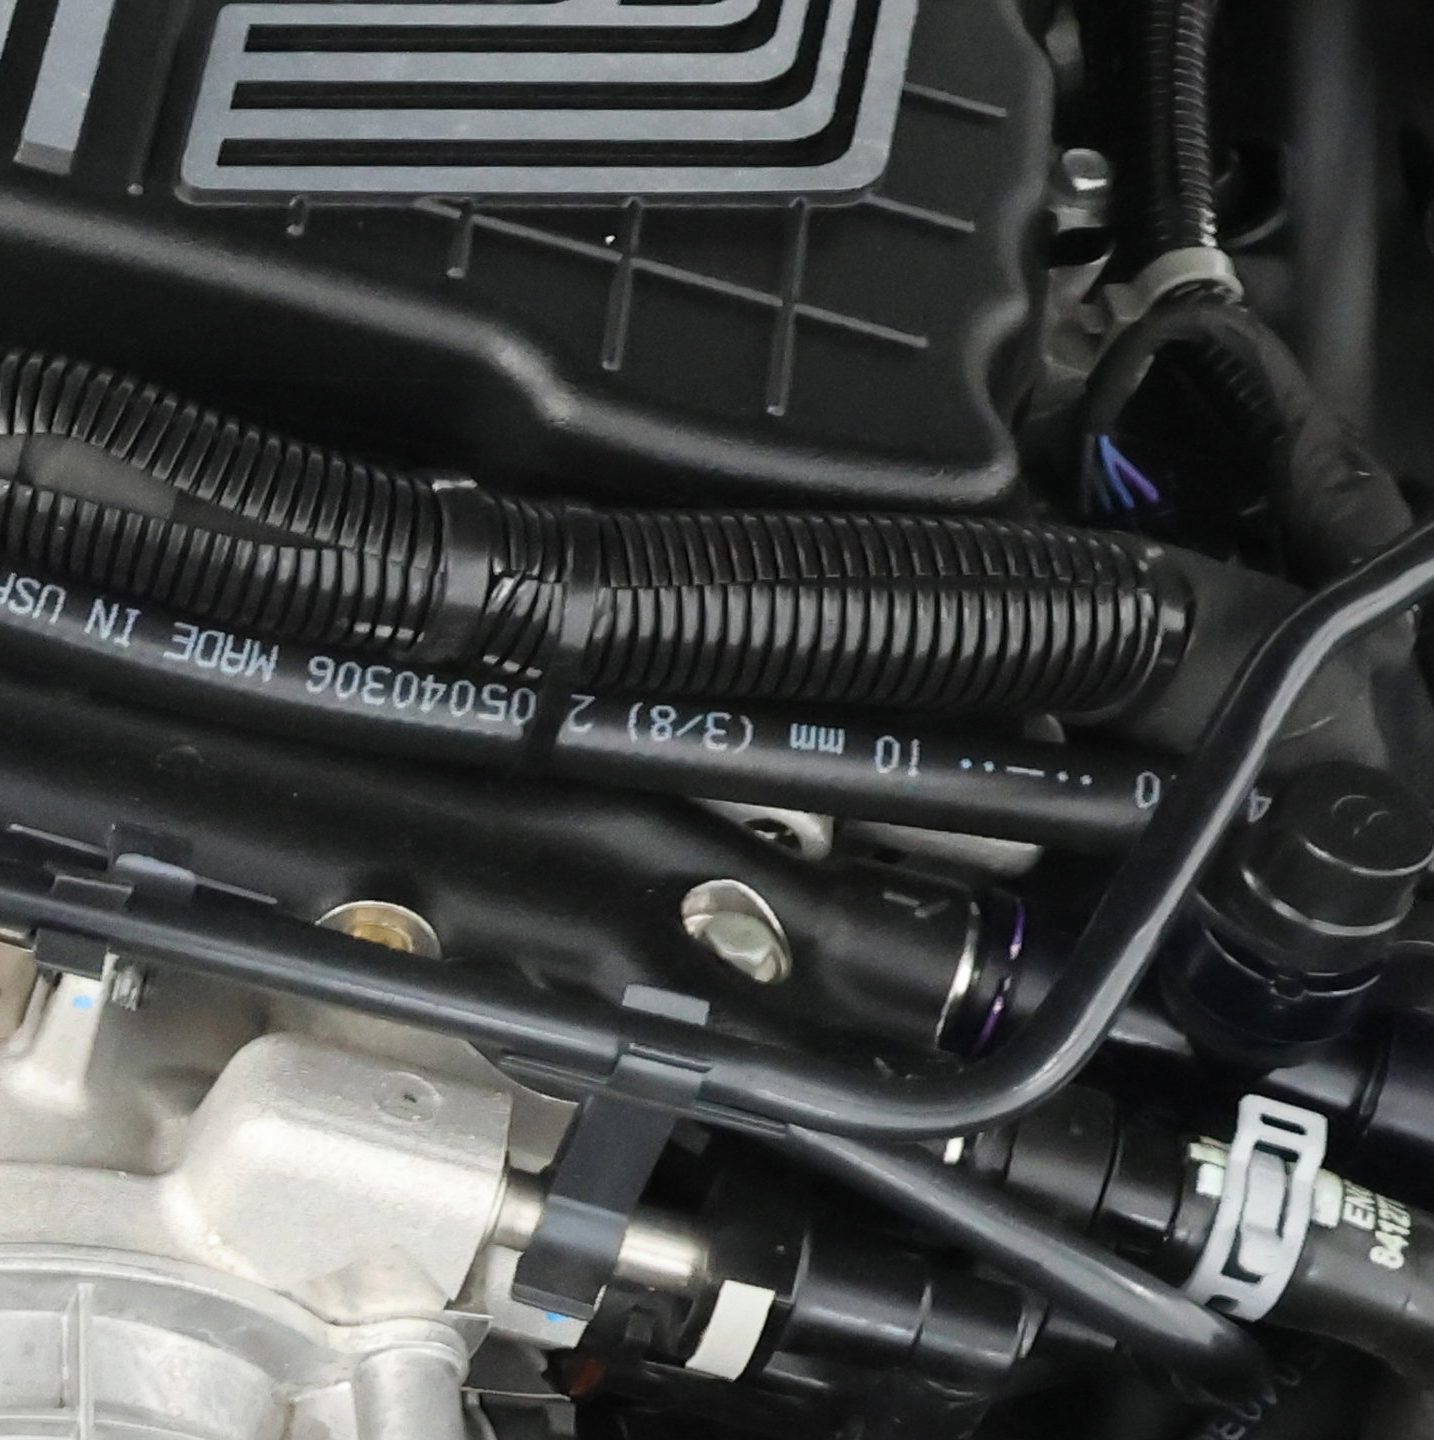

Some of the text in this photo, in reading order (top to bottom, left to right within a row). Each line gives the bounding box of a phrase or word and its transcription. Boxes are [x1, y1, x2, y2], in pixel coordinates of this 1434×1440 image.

[85, 597, 141, 648] IN
[163, 621, 280, 682] MADE
[308, 655, 539, 726] 05040306
[626, 701, 754, 754] (3/8)
[789, 723, 846, 755] mm
